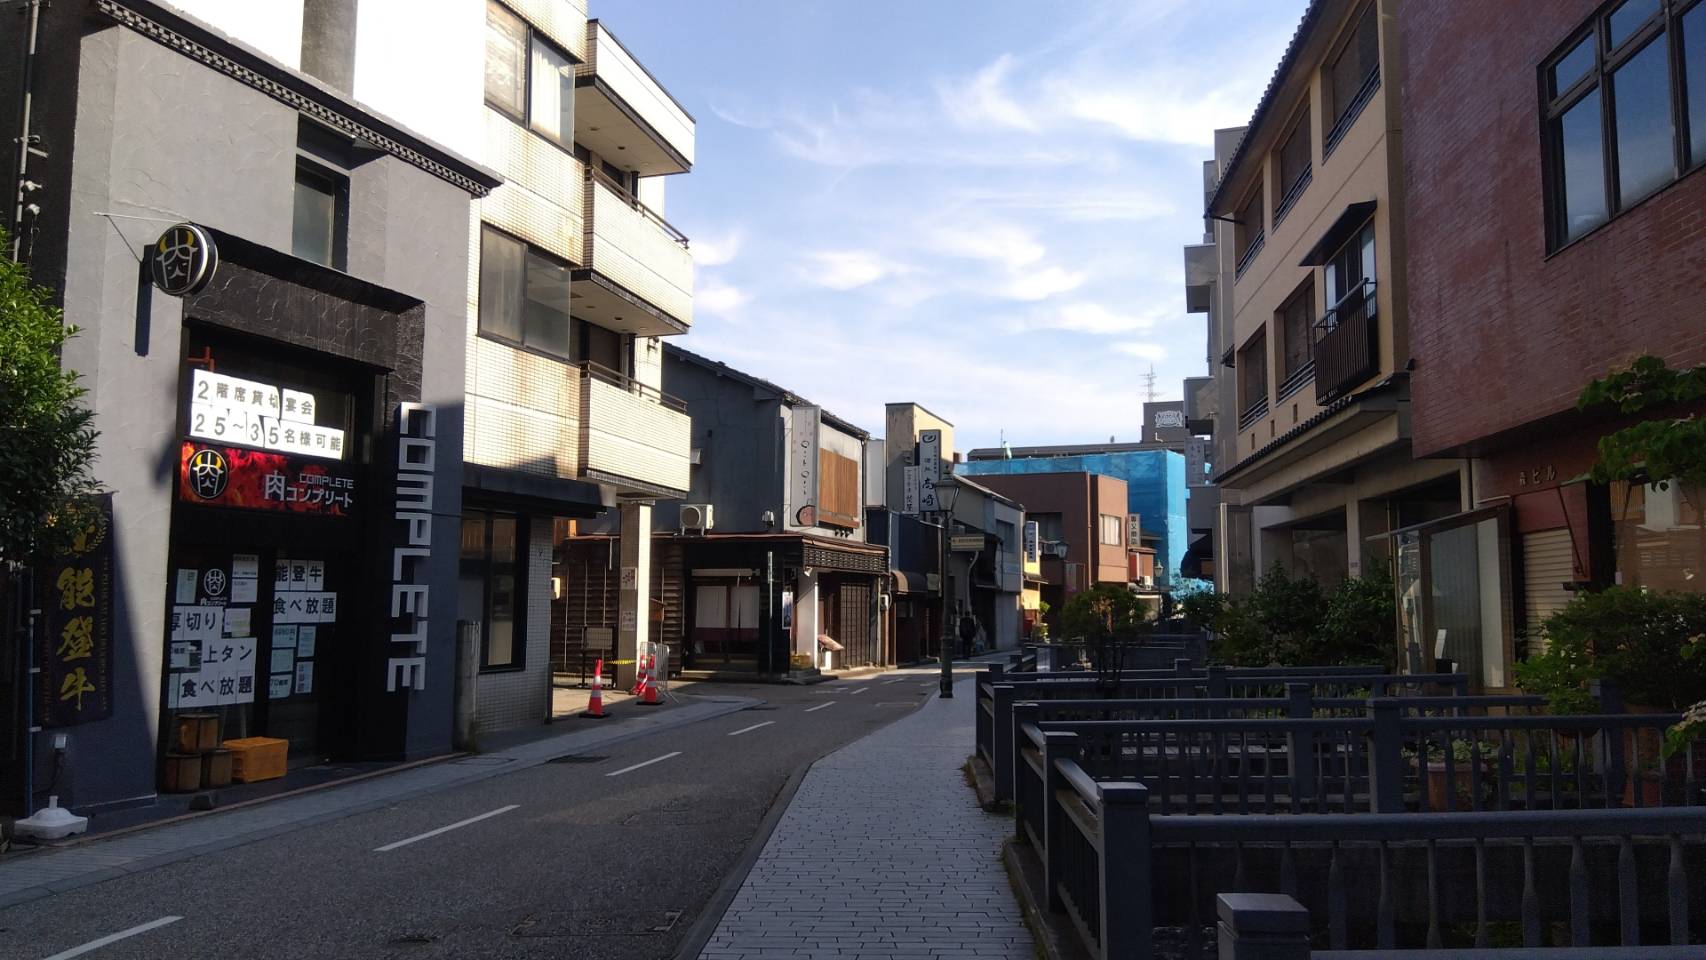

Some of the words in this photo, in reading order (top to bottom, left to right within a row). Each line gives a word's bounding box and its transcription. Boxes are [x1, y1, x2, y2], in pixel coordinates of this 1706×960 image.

[299, 473, 354, 489] COMPLETE
[387, 402, 436, 692] COMPLETE
[275, 564, 321, 582] 能登牛
[273, 597, 334, 615] 食べ放題
[171, 611, 217, 632] 厚切り
[56, 566, 96, 712] 能登牛
[203, 645, 253, 664] 上タン
[181, 675, 253, 699] 食べ放題
